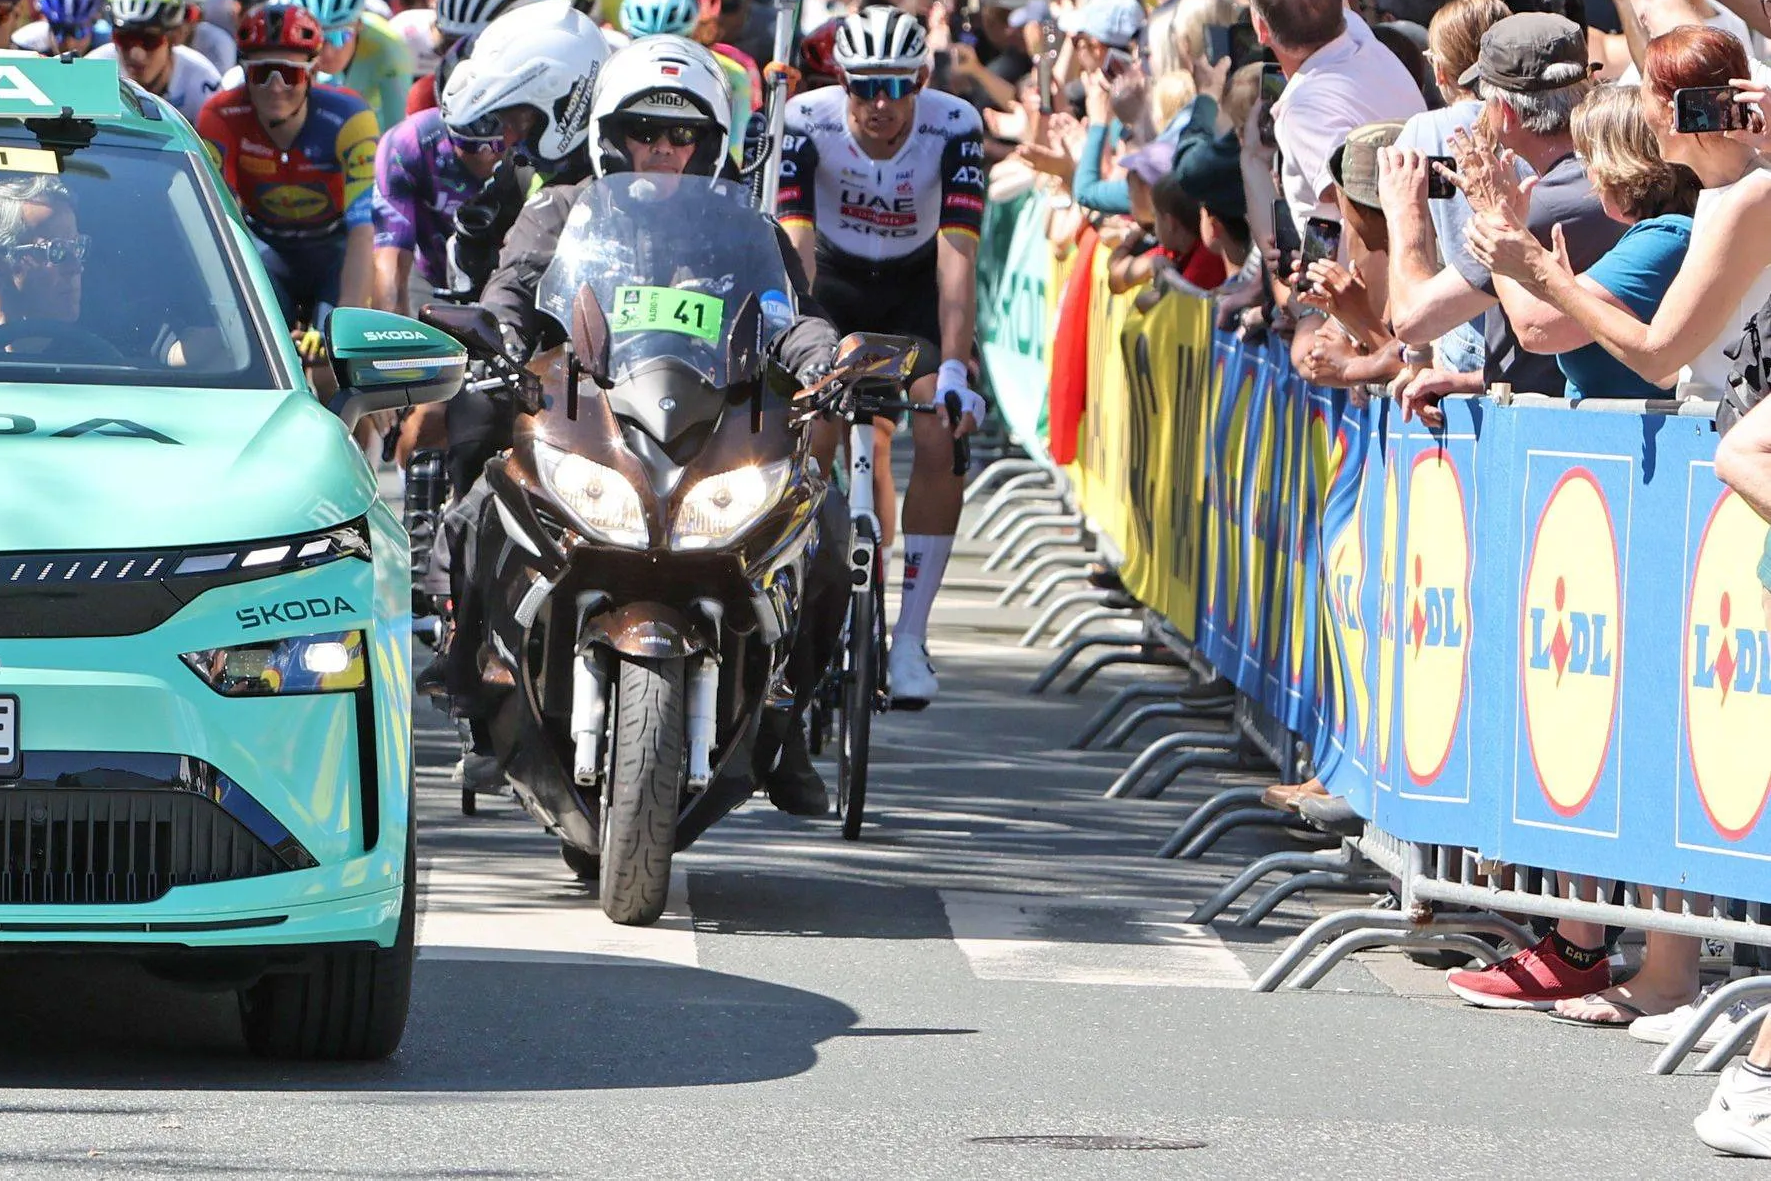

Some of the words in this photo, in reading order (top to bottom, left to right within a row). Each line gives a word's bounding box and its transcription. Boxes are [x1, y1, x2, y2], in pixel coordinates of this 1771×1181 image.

[841, 189, 915, 213] UAE
[673, 300, 705, 329] 41
[639, 635, 672, 646] YAMAHA
[1564, 946, 1593, 966] CAT
